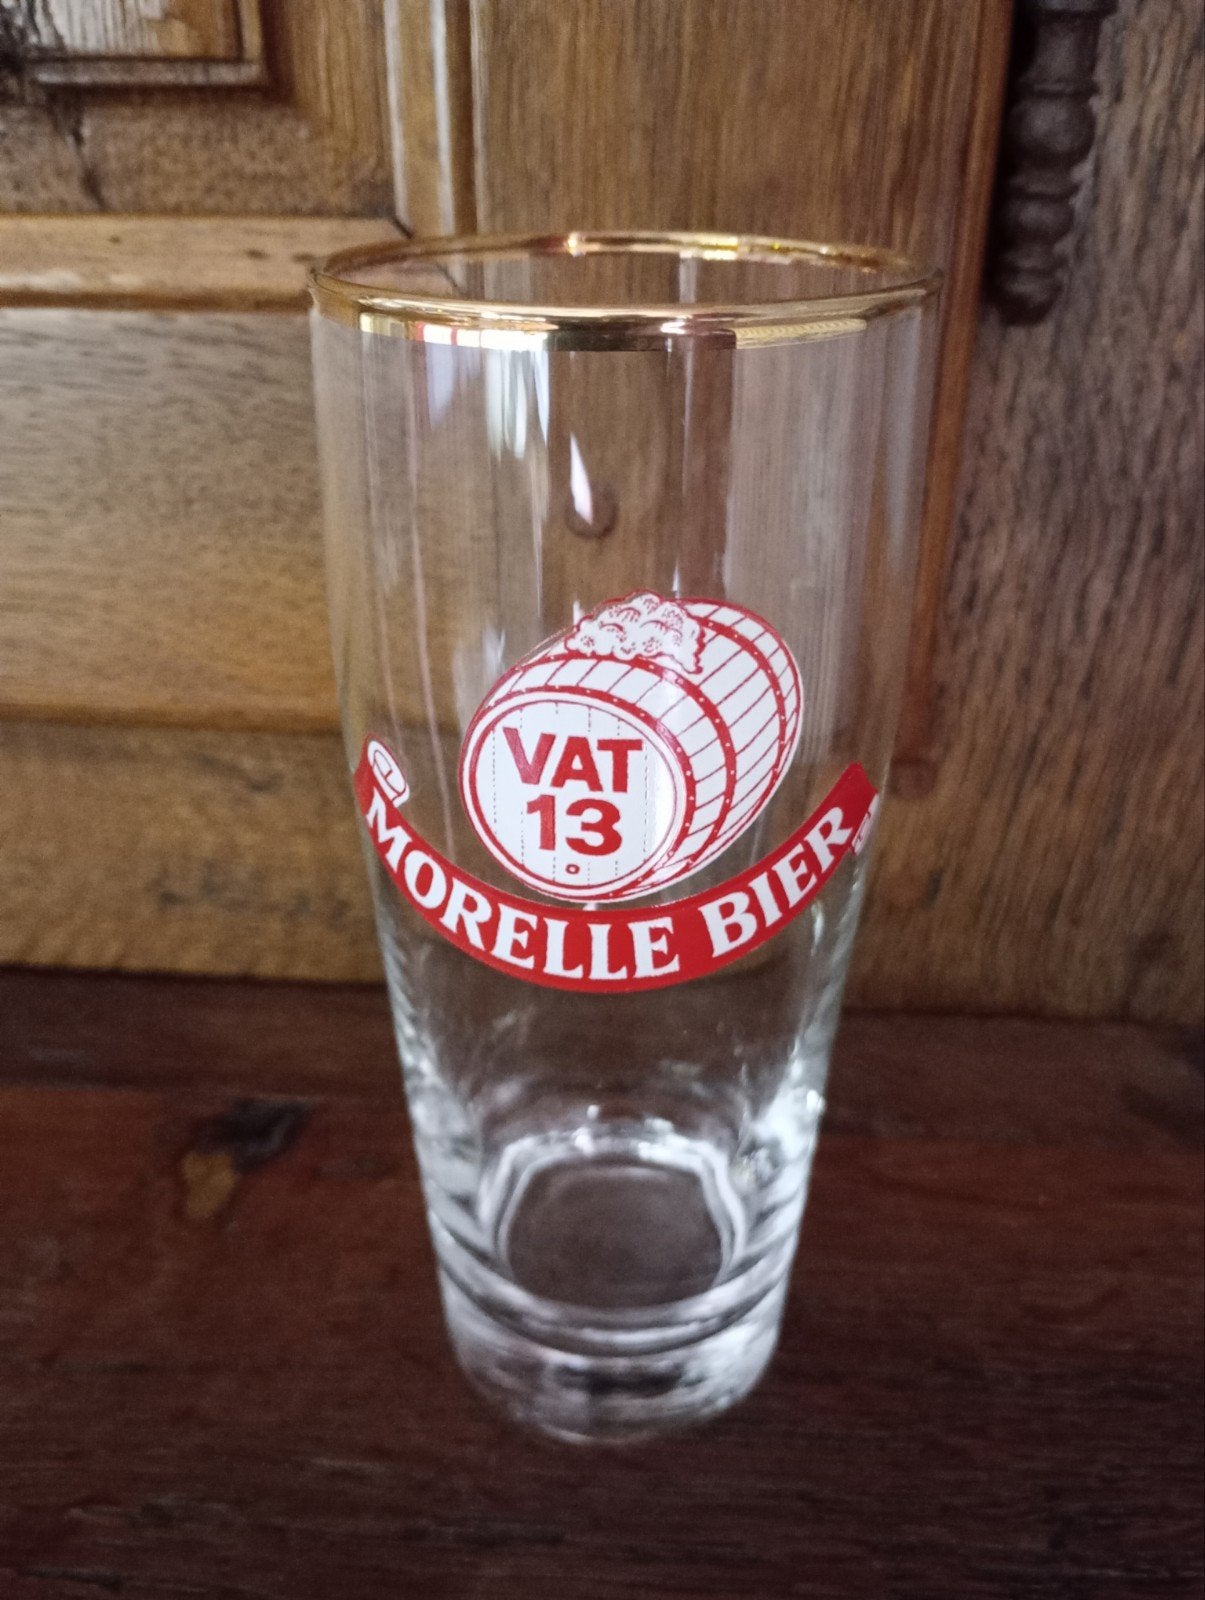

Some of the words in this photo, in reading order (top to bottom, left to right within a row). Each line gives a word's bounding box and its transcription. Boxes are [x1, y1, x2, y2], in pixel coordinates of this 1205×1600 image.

[503, 727, 643, 793] VAT
[527, 794, 623, 856] 13
[366, 786, 680, 980] MORELLE
[699, 806, 853, 958] BIER
